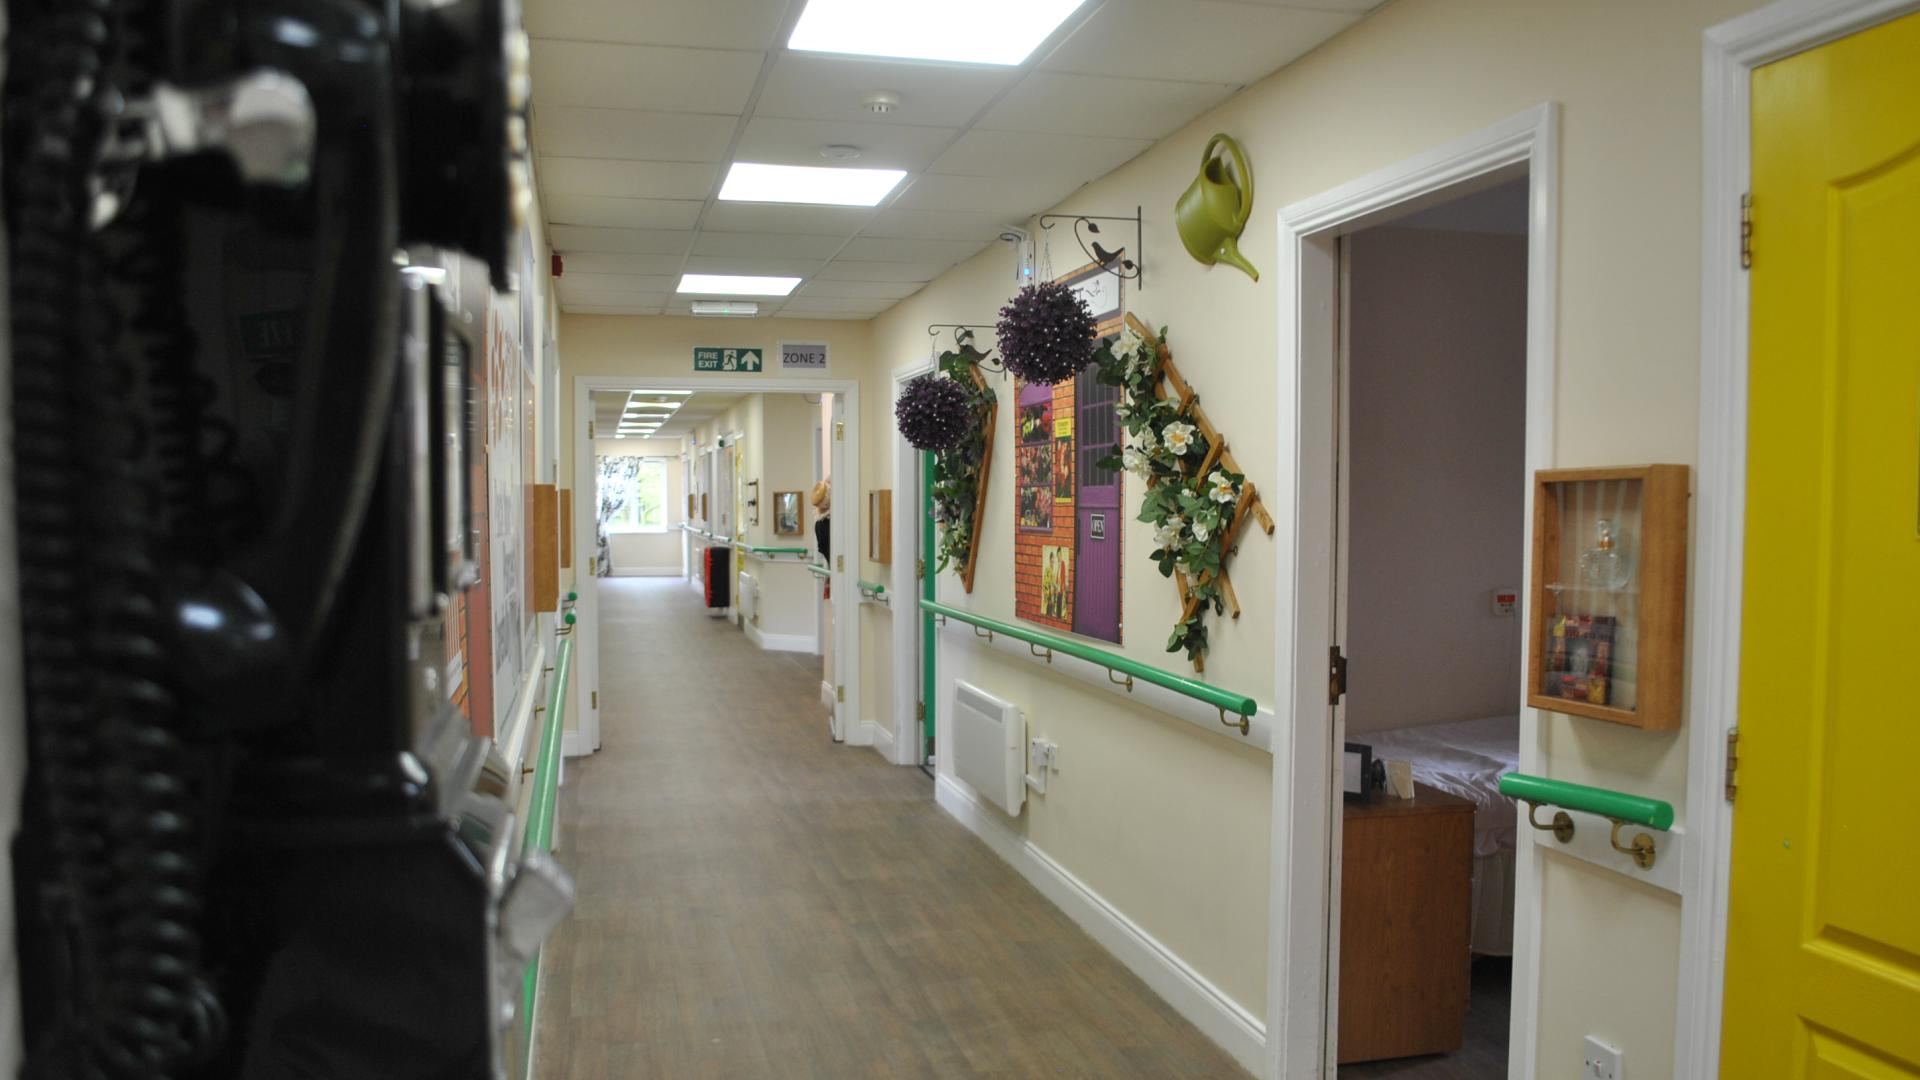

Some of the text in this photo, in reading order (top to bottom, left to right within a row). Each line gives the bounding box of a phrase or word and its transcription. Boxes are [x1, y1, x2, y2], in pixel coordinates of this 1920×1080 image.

[783, 353, 825, 363] ZONE 2
[1091, 519, 1104, 533] OPEN
